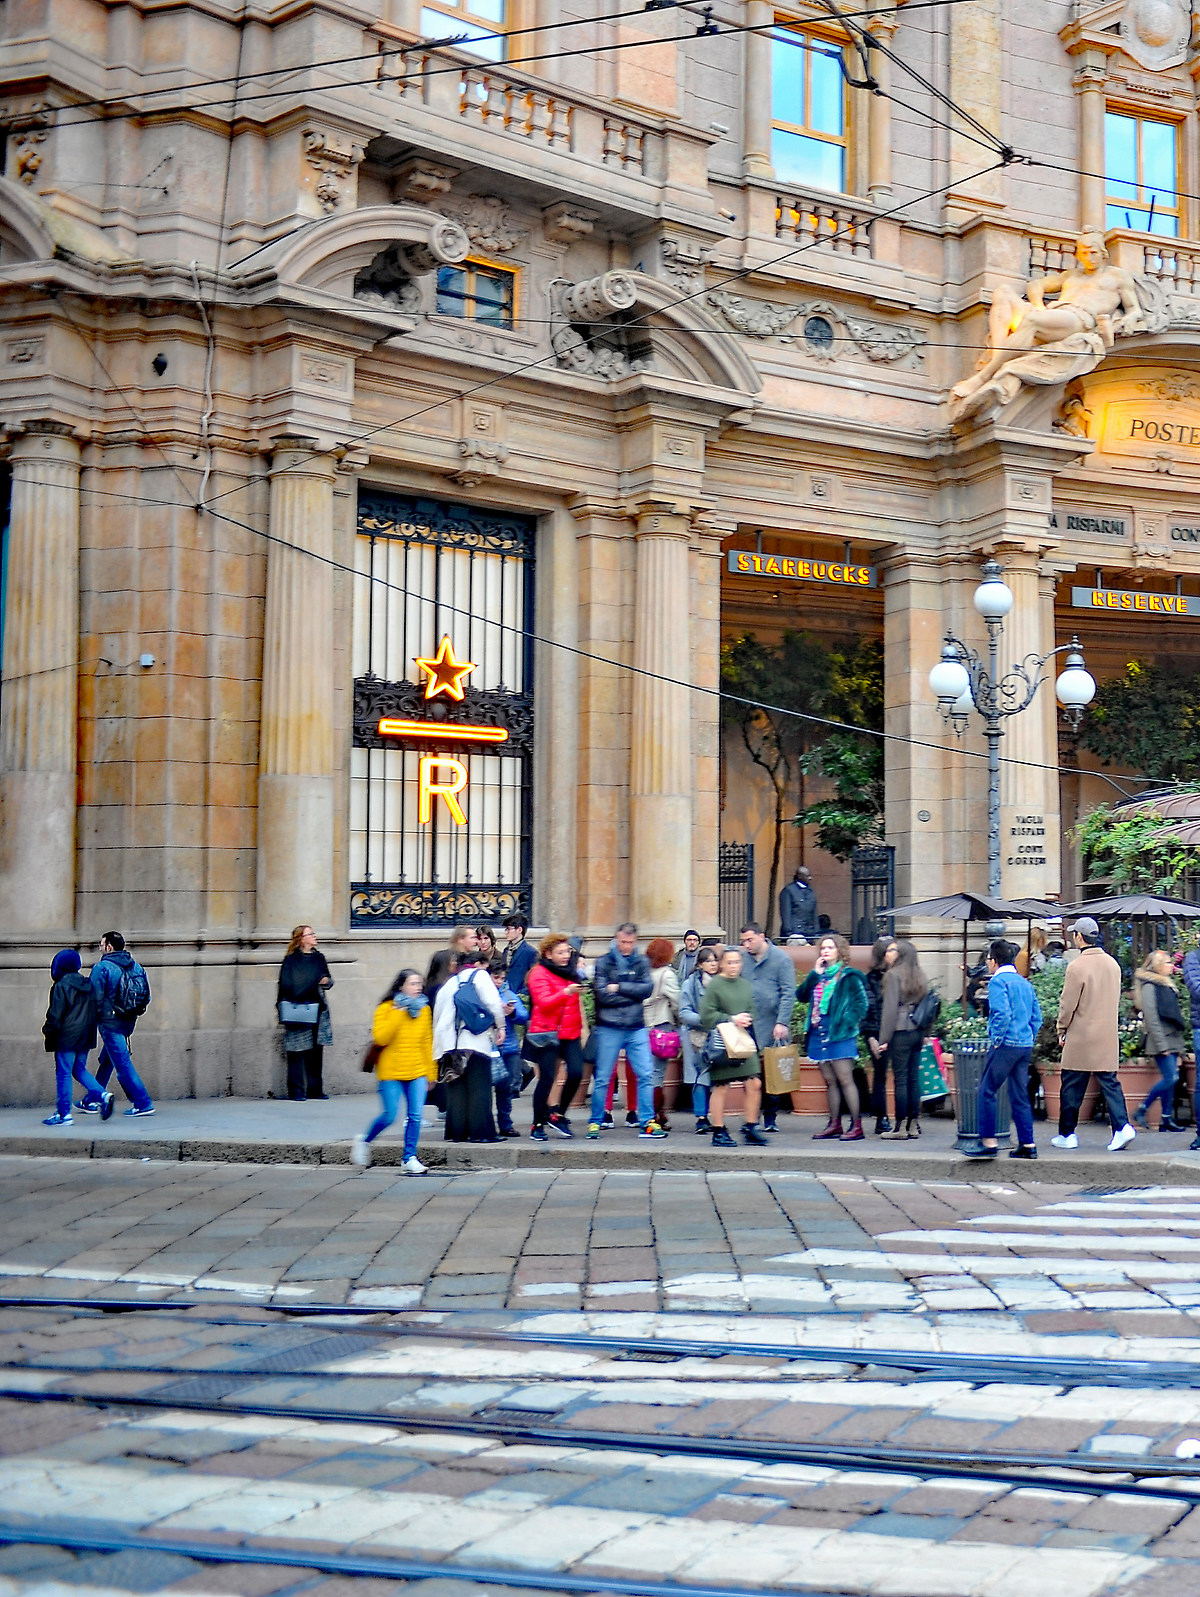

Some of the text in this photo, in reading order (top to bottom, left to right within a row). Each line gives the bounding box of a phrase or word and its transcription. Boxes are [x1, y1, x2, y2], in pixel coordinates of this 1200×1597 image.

[1066, 515, 1125, 536] RISPARMI
[737, 553, 871, 586] STARBUCKS
[1091, 590, 1188, 613] RESERVE
[419, 756, 468, 825] R
